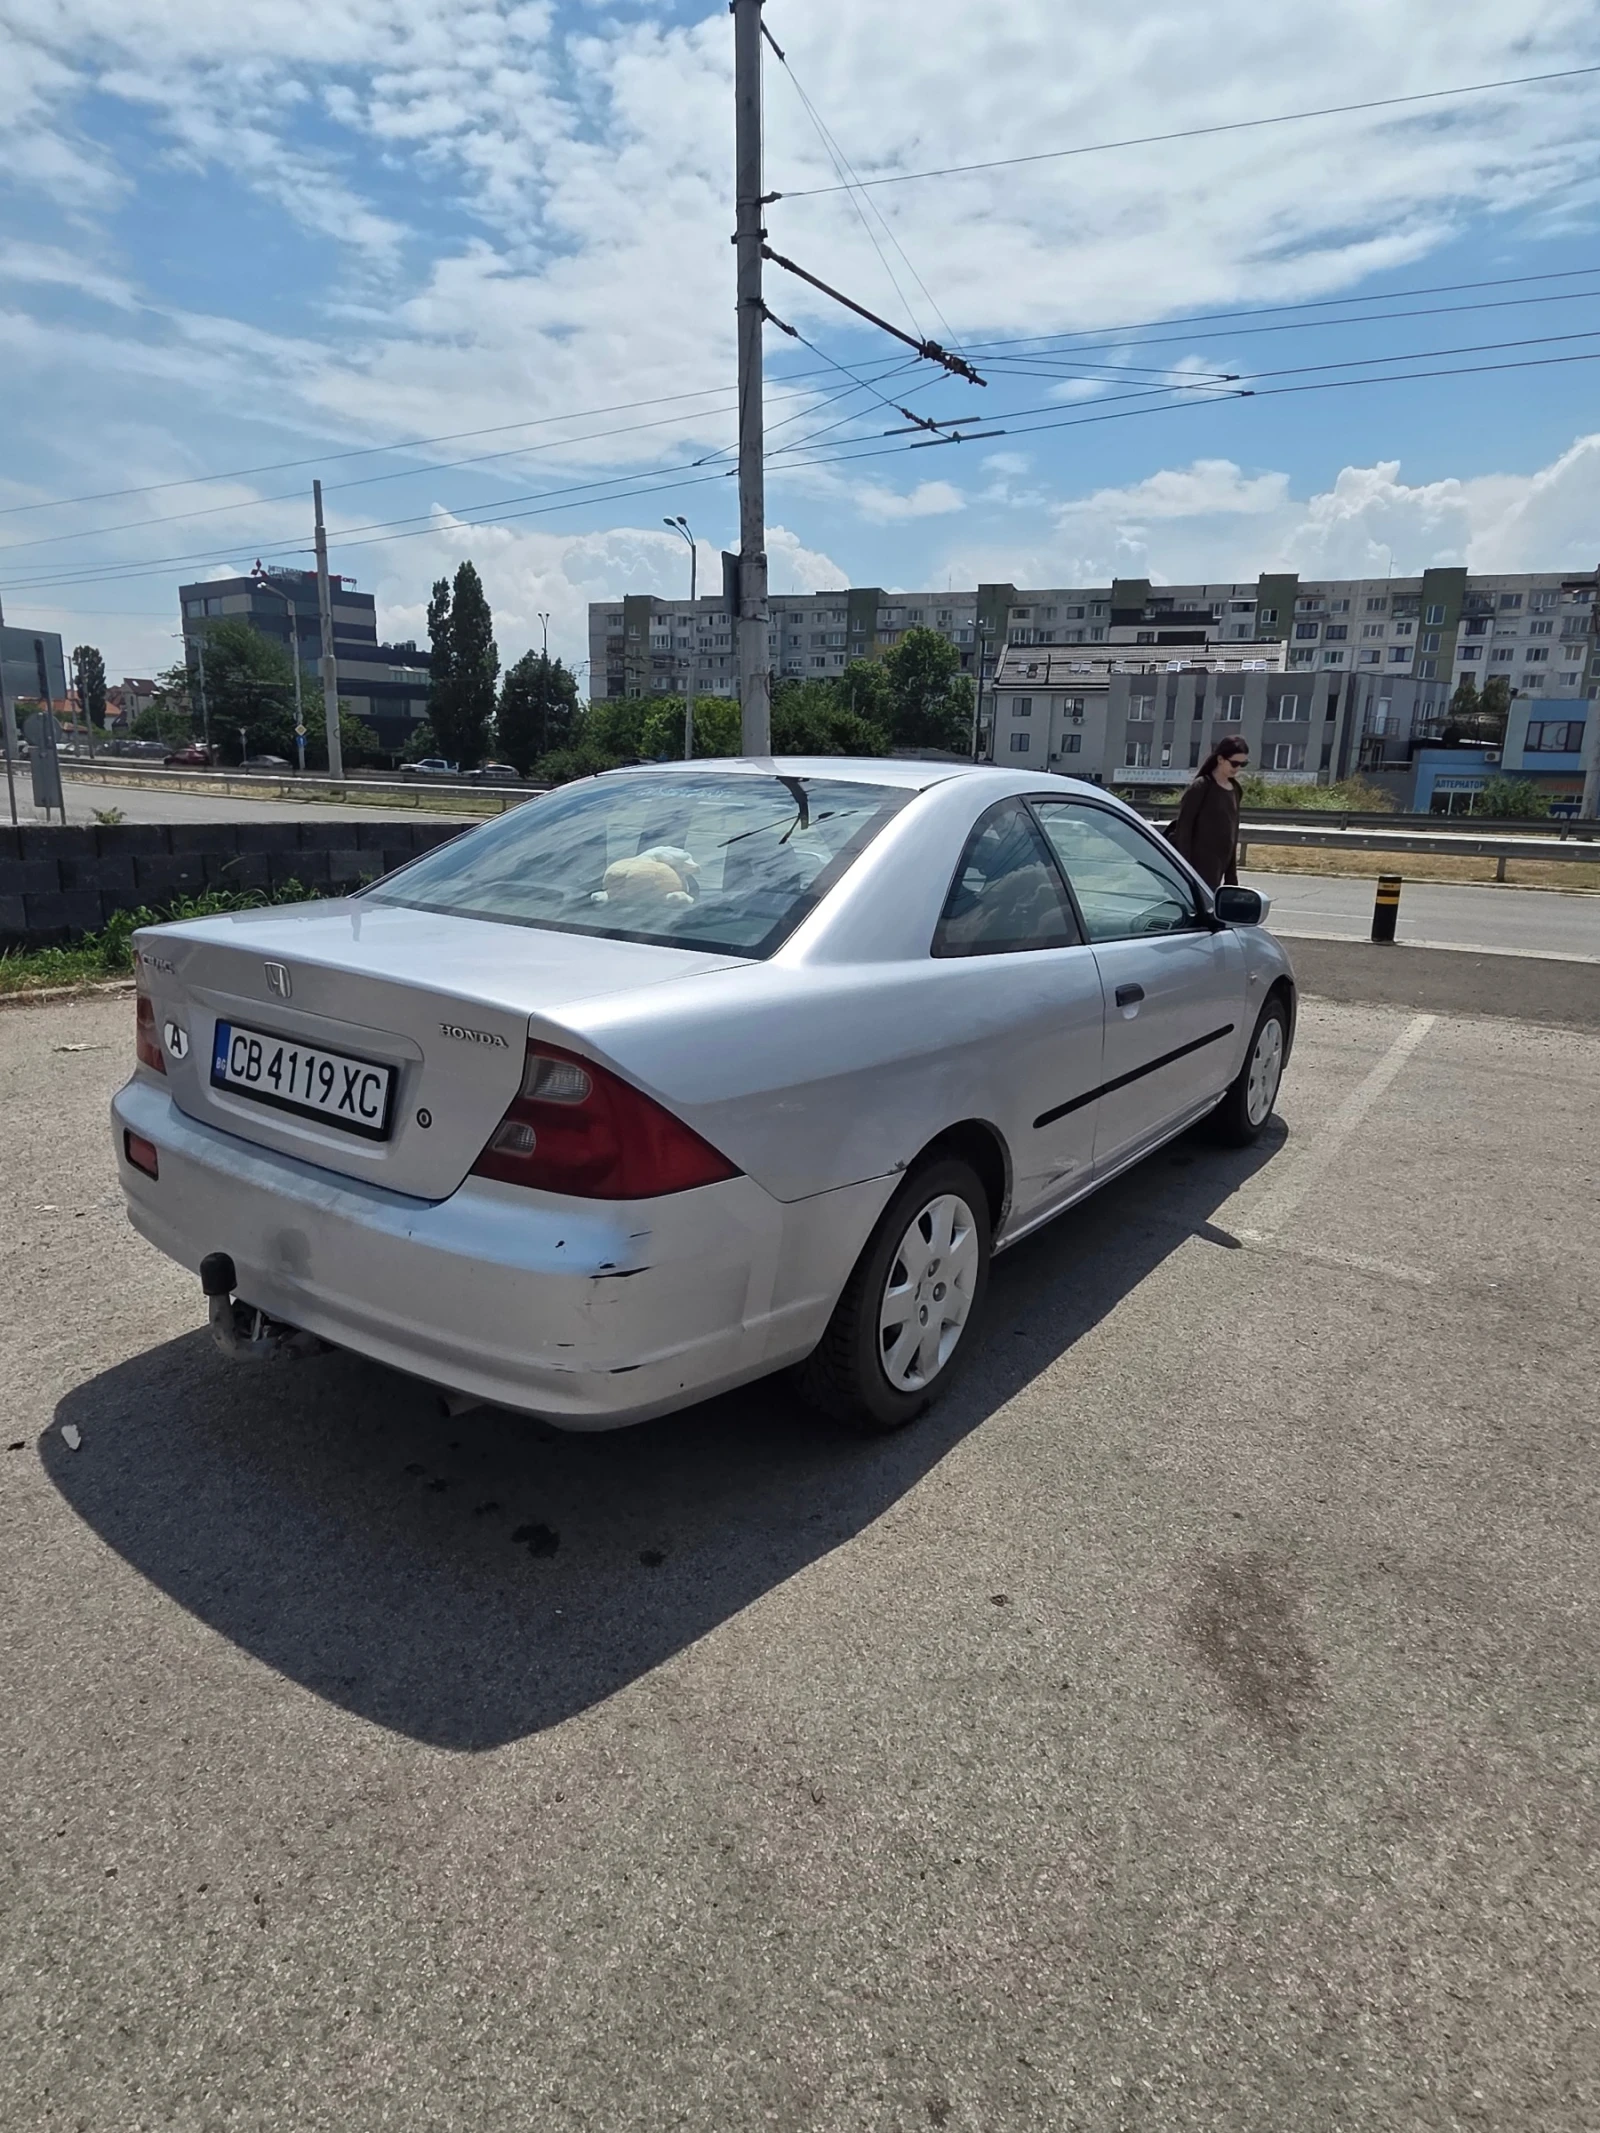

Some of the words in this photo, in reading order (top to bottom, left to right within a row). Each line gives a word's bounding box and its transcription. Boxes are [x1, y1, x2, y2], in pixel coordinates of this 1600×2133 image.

[170, 1025, 183, 1055] A
[438, 1023, 509, 1049] HONDA
[216, 1056, 226, 1071] BG
